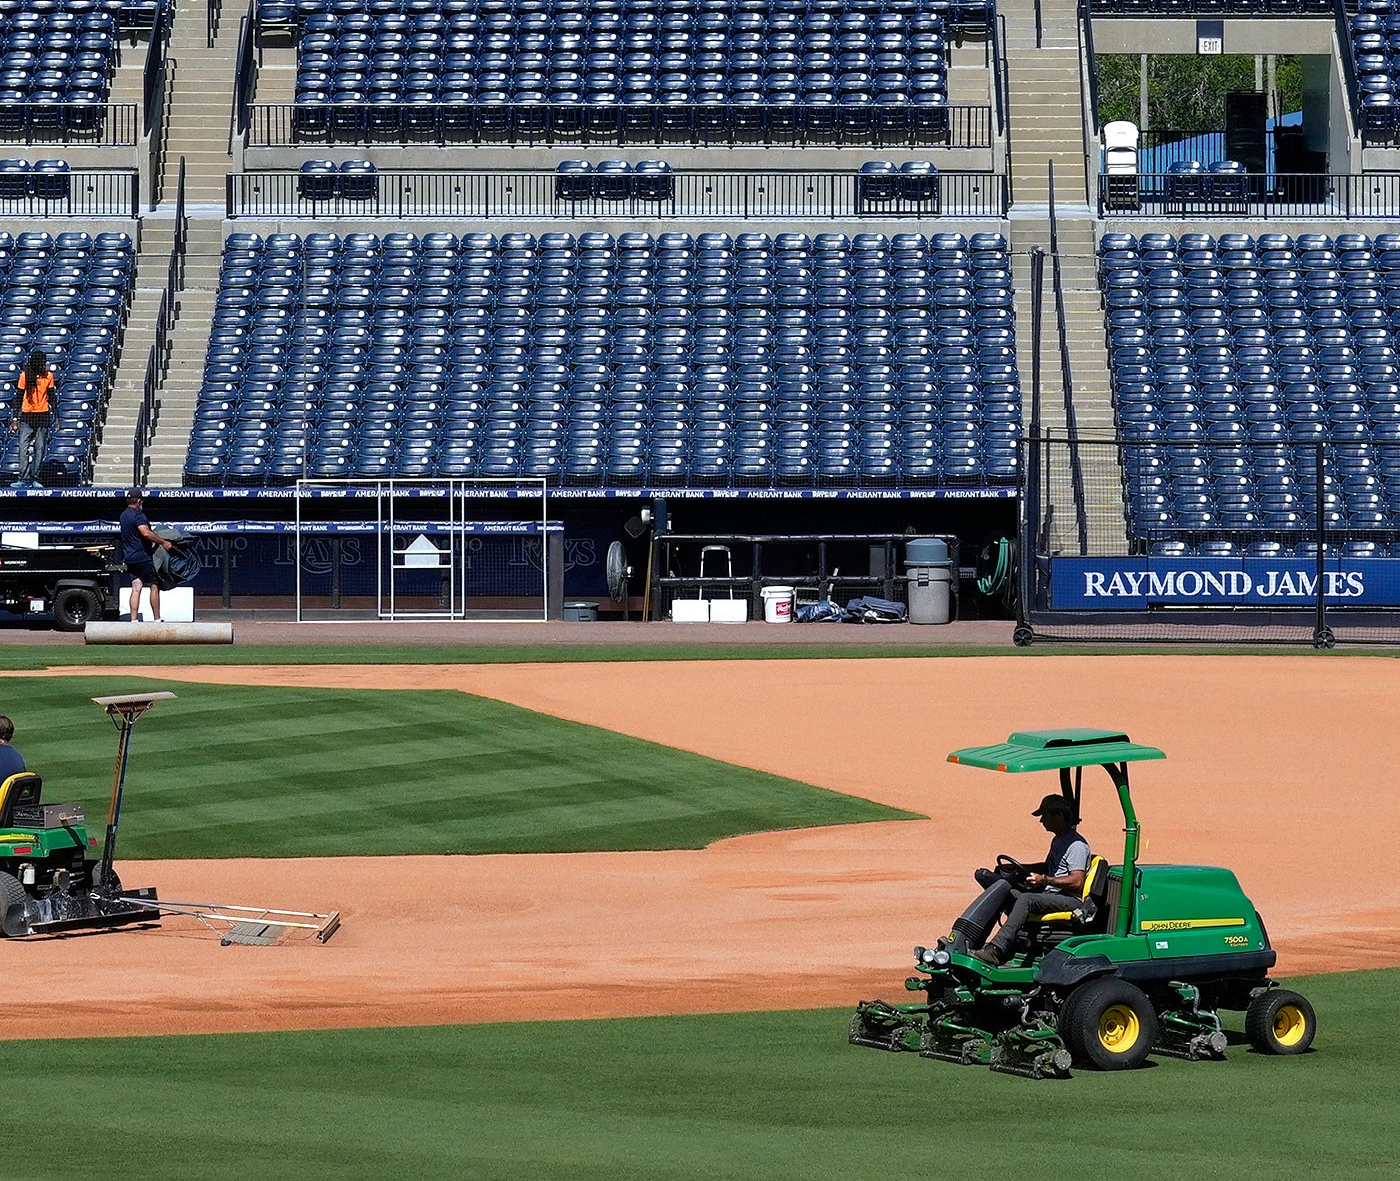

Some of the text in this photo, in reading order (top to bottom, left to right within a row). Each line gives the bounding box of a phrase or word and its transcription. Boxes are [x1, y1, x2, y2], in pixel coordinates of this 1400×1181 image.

[1203, 40, 1218, 51] EXIT
[61, 490, 97, 498] AMERANT
[97, 490, 116, 498] BANK
[159, 490, 214, 498] AMERANT BANK
[257, 490, 293, 498] AMERANT
[490, 490, 509, 498] BANK
[552, 490, 607, 498] AMERANT BANK
[748, 491, 803, 499] AMERANT BANK
[847, 491, 902, 499] AMERANT BANK
[944, 491, 980, 499] AMERANT
[980, 491, 999, 499] BANK
[1083, 571, 1364, 597] RAYMOND JAMES
[1149, 921, 1192, 931] JOHN DEERE
